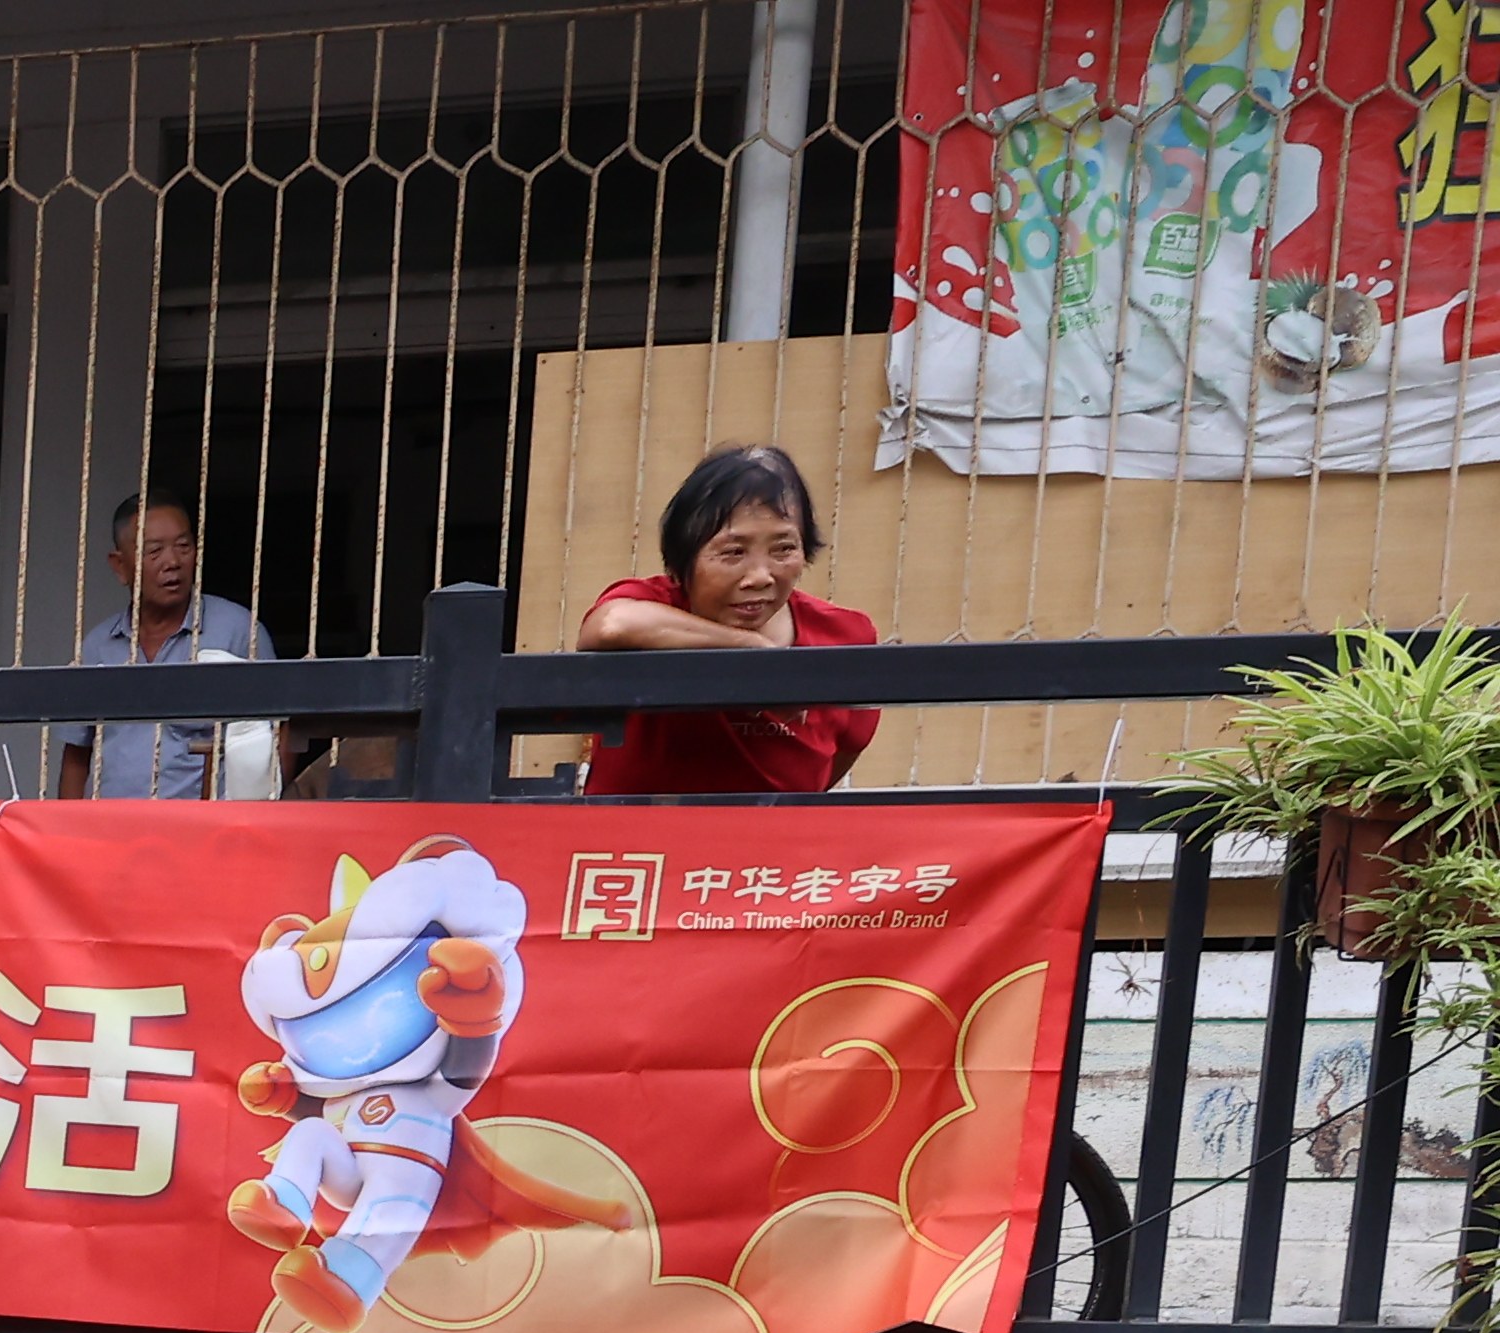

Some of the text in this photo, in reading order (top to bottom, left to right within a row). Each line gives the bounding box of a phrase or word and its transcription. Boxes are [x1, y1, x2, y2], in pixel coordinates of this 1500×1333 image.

[682, 863, 959, 906] 中华老字号
[676, 908, 950, 932] China Time-honored Brand
